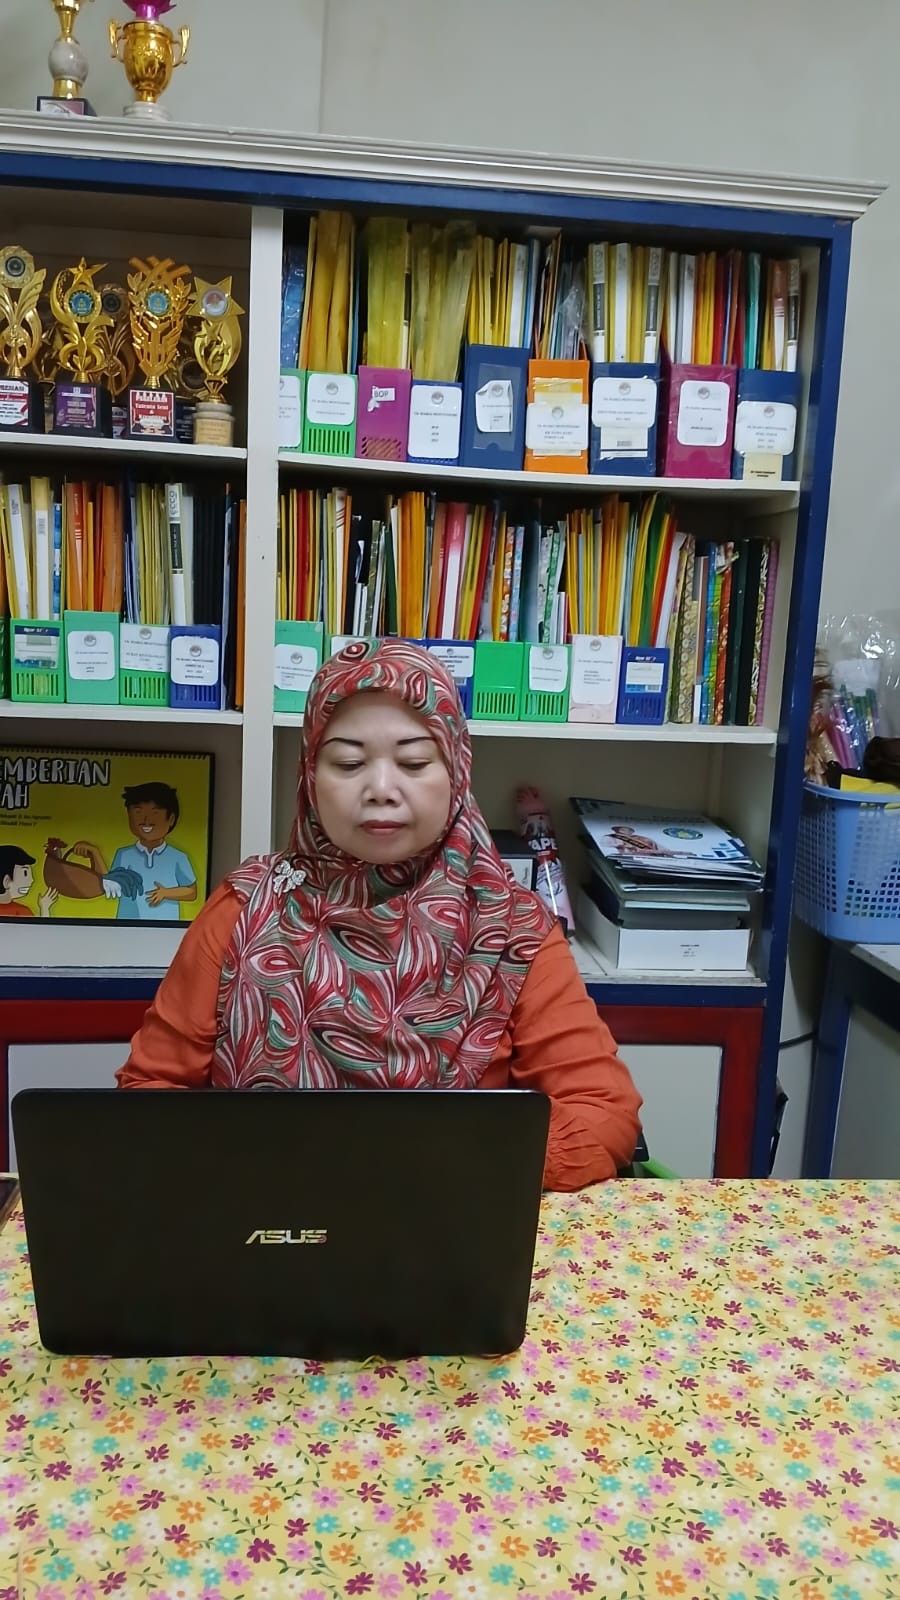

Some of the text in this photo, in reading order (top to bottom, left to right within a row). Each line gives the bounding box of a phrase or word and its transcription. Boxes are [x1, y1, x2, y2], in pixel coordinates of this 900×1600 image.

[374, 389, 389, 398] BOP
[0, 757, 109, 786] MBERIAN
[0, 783, 28, 809] AH
[245, 1229, 327, 1244] ASUS
